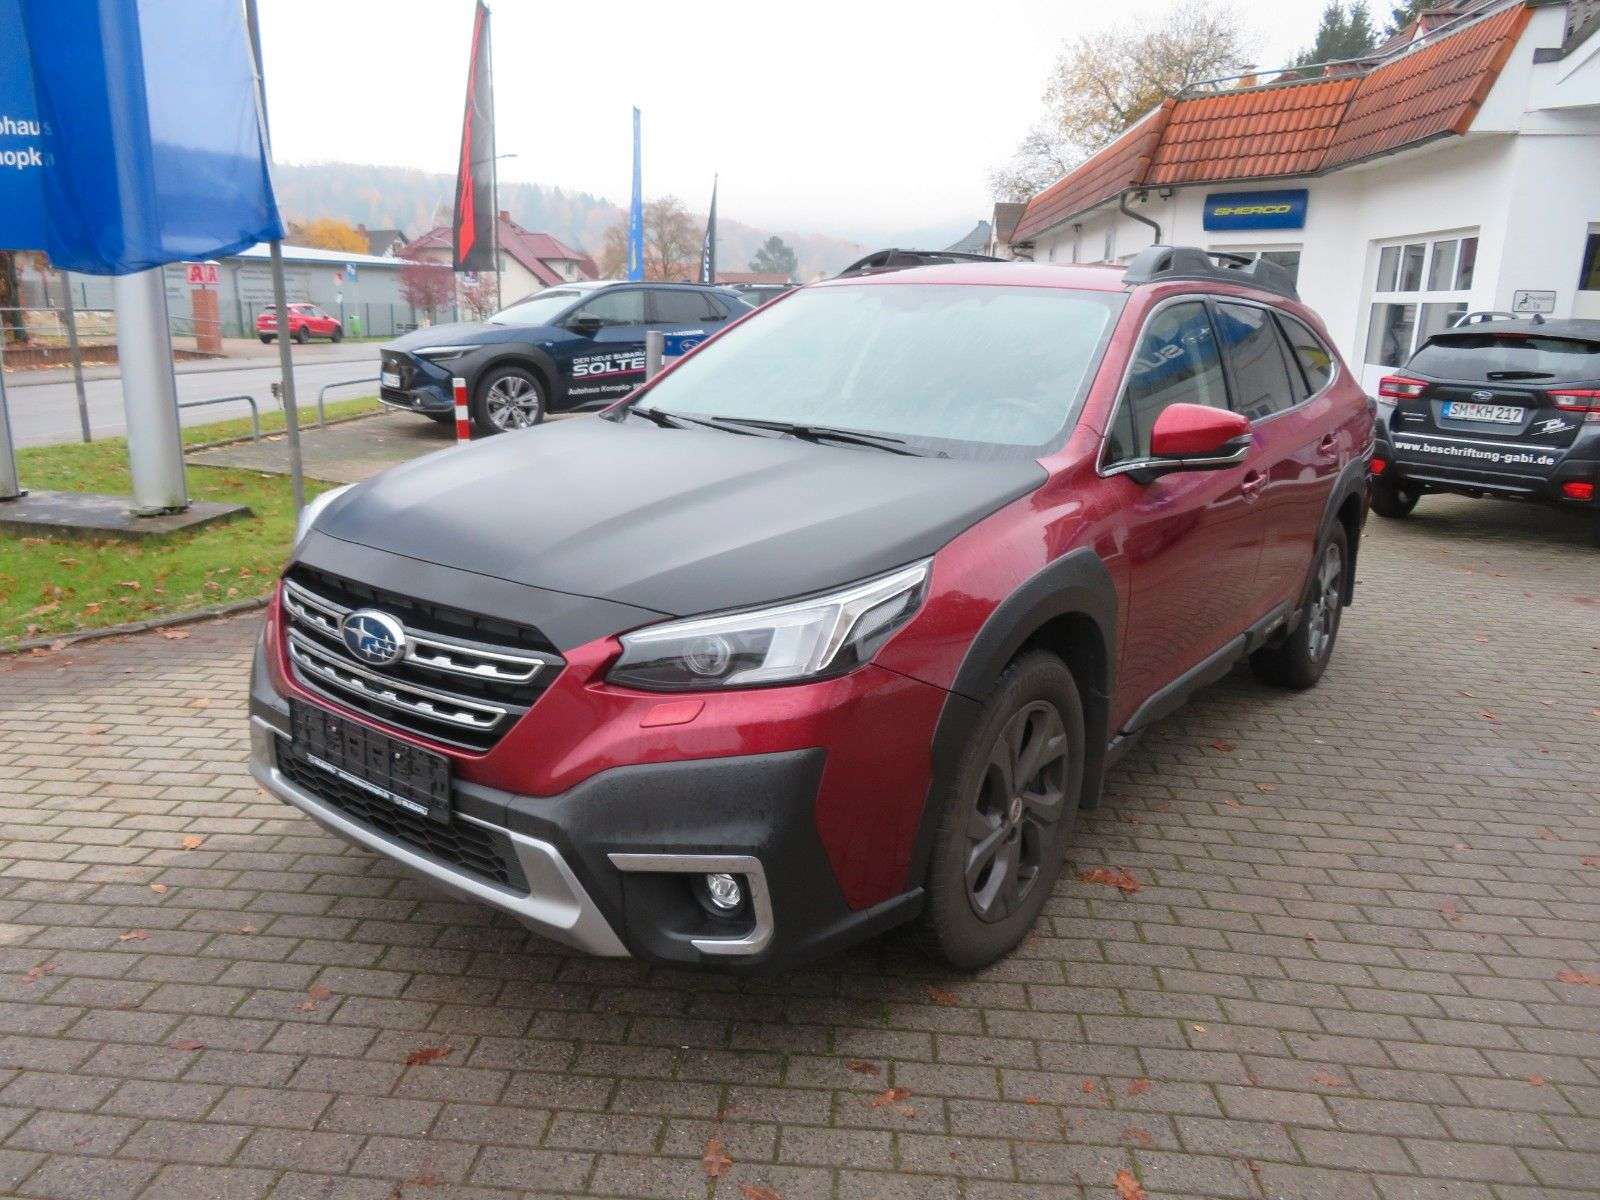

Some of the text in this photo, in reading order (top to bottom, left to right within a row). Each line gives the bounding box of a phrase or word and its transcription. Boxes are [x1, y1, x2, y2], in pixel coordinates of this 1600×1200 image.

[573, 351, 646, 365] DER NEUE SUBARU
[572, 357, 645, 377] SOLTE
[568, 386, 600, 395] Autohaus
[1495, 406, 1521, 420] 217
[1394, 441, 1555, 466] www.beschriftung-gabi.de
